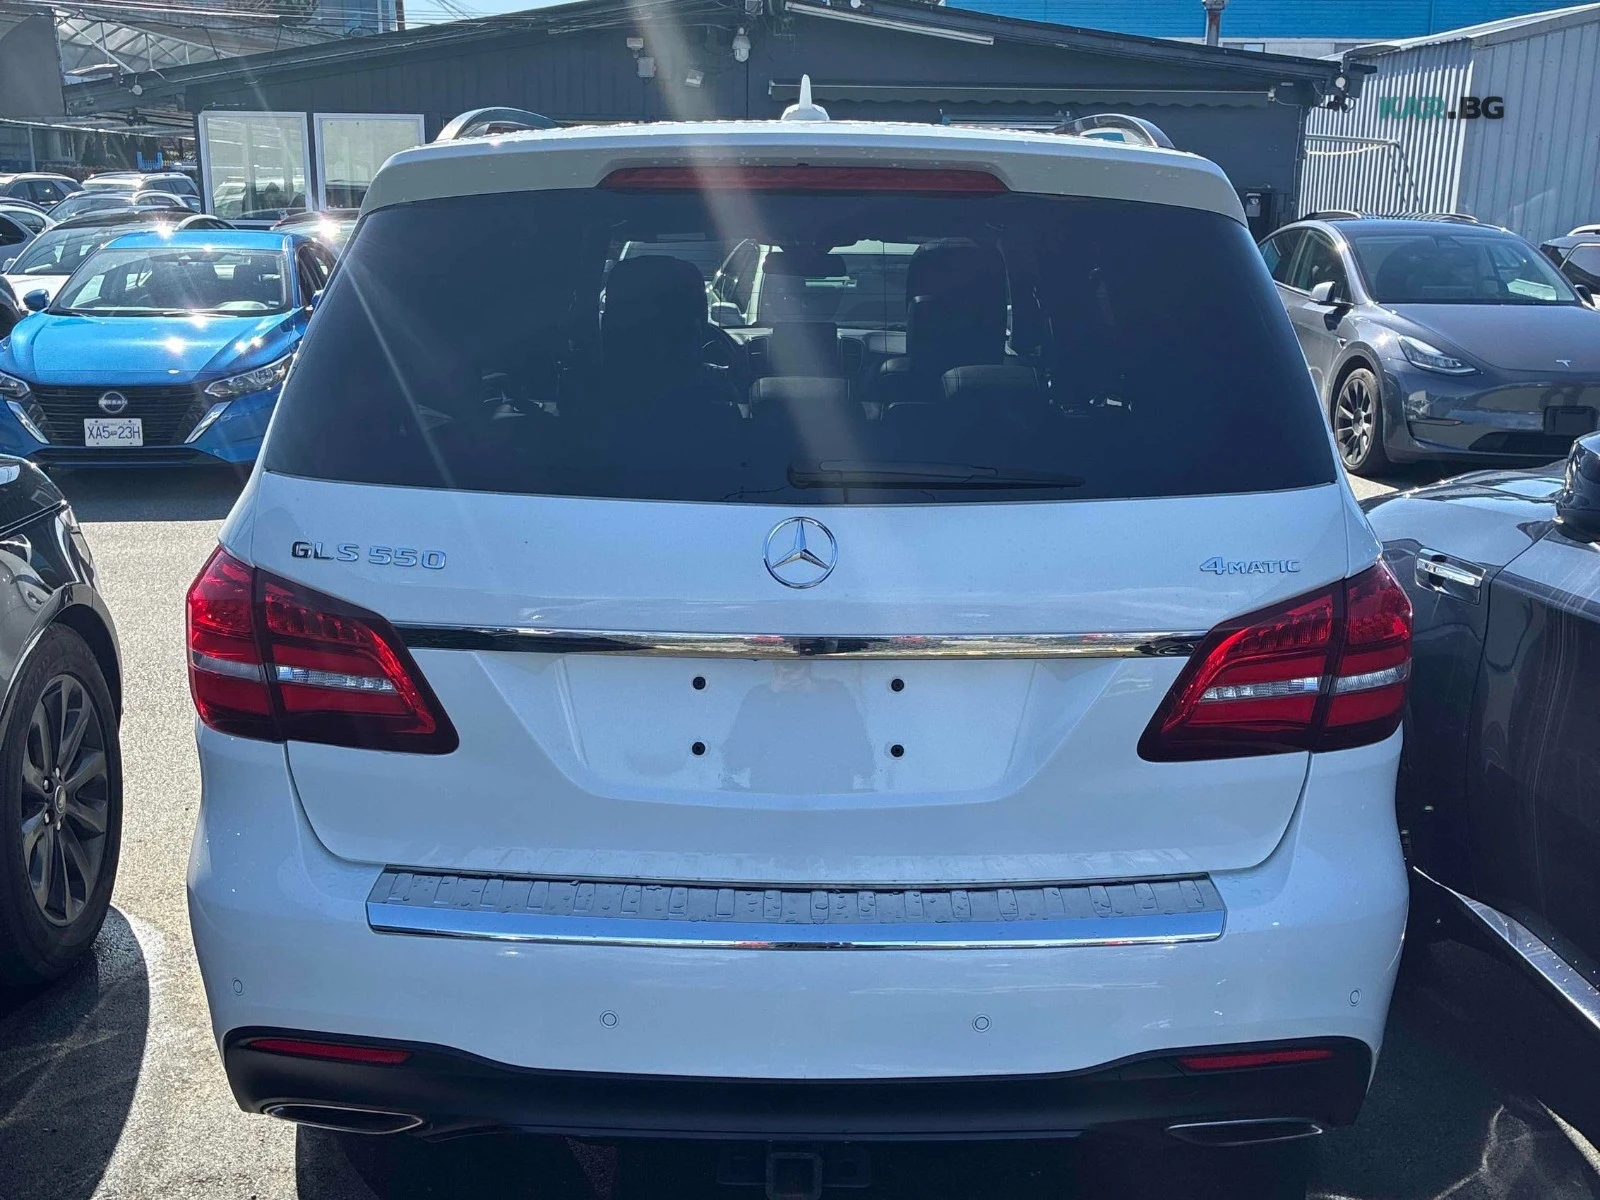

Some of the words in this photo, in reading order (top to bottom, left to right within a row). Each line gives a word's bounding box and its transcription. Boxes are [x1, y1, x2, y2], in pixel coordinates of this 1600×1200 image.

[291, 541, 359, 562] GLS
[368, 546, 447, 570] 550
[1200, 556, 1301, 575] 4MATIC
